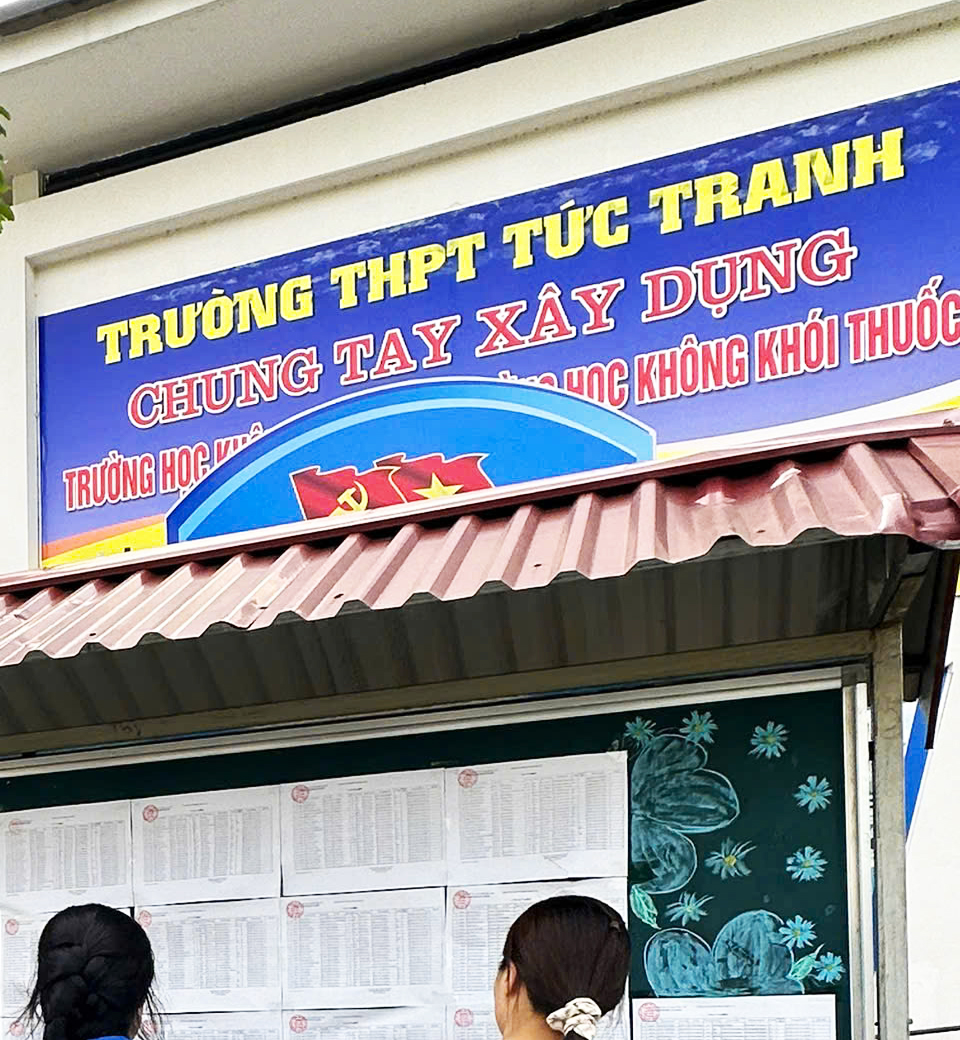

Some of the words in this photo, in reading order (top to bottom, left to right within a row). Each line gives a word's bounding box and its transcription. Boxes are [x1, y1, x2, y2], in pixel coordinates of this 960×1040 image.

[96, 287, 315, 365] TRƯỜNG
[330, 231, 486, 309] THPT
[502, 196, 630, 269] TỨC
[648, 126, 905, 234] TRANH
[129, 347, 322, 428] CHUNG
[334, 315, 461, 385] TAY
[475, 279, 625, 357] XÂY
[642, 227, 857, 317] DỤNG
[64, 450, 155, 511] TRƯỜNG
[635, 334, 749, 405] KHÔNG
[755, 308, 839, 382] KHÓI
[845, 275, 960, 364] THUỐC
